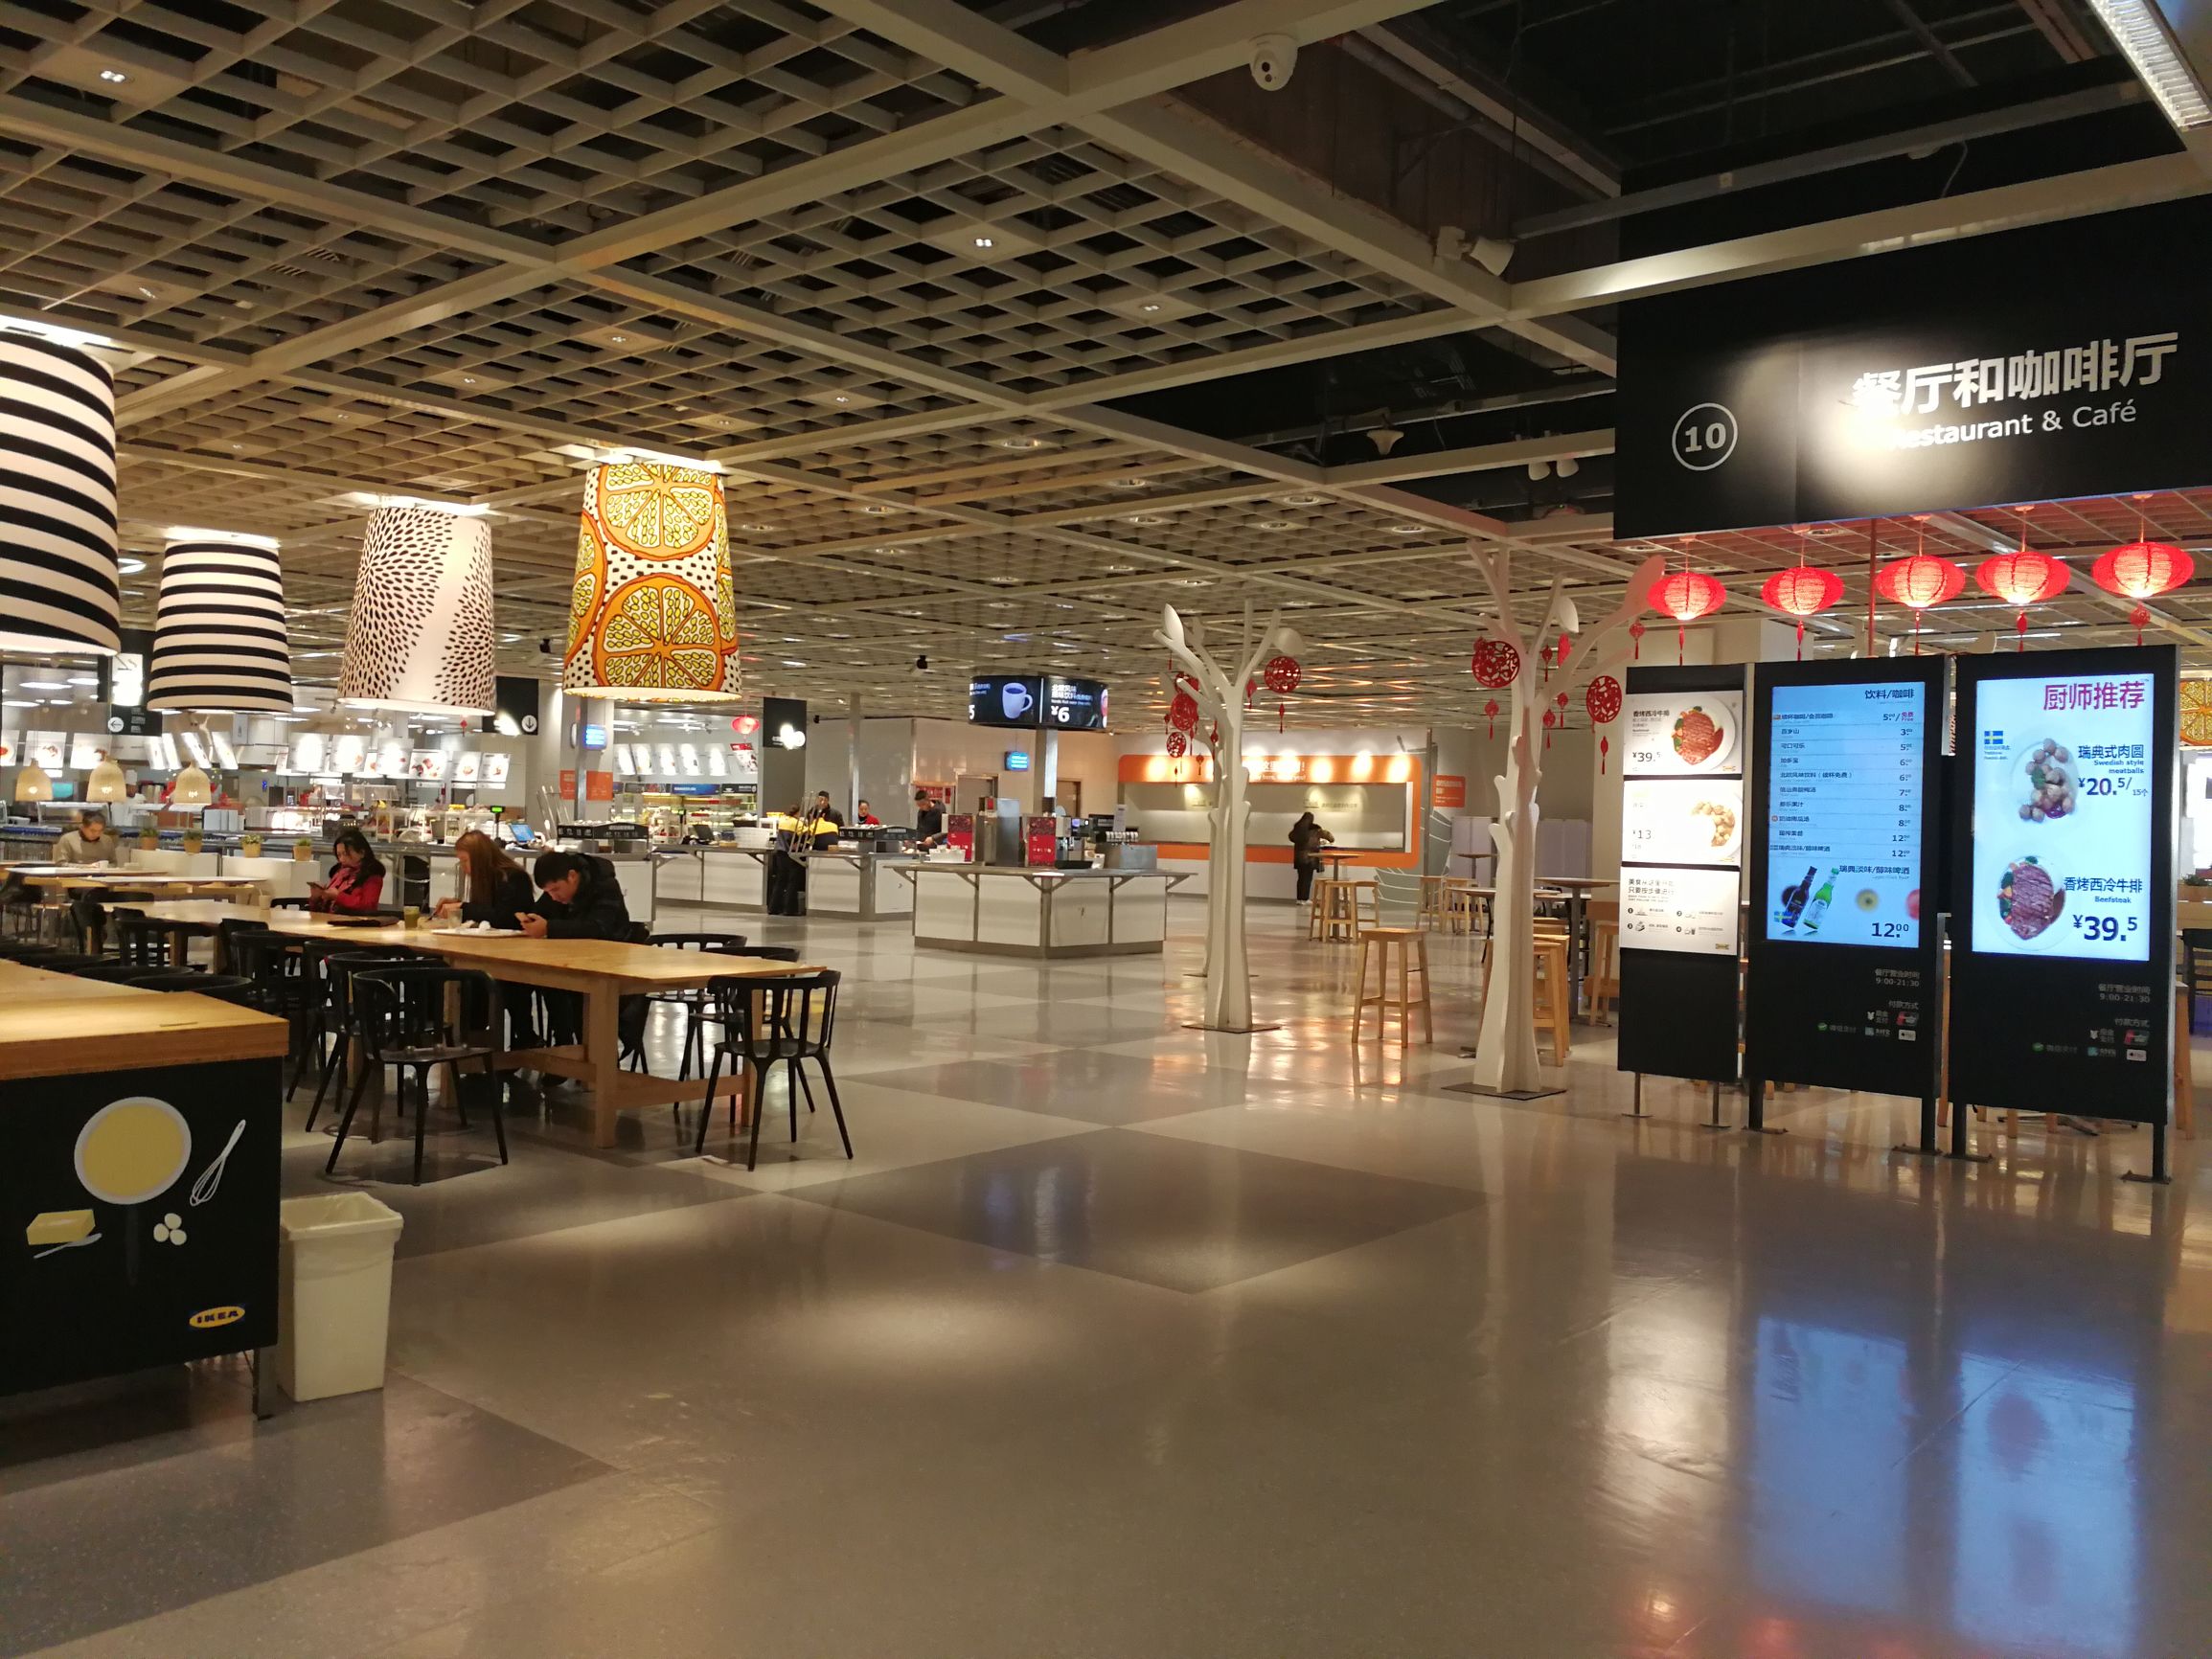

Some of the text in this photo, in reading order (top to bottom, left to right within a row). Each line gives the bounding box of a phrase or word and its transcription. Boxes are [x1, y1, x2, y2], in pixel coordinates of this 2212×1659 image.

[1852, 331, 2178, 419] 餐厅和咖啡厅
[2041, 410, 2064, 431] &
[2072, 398, 2136, 427] Café
[1685, 422, 1726, 452] 10
[1864, 689, 1915, 699] 饮料/咖啡
[2043, 681, 2145, 711] 厨师推荐
[2078, 744, 2144, 759] 瑞典式肉圆
[2064, 877, 2143, 893] 香烤西冷牛排
[197, 1310, 239, 1324] IKEA
